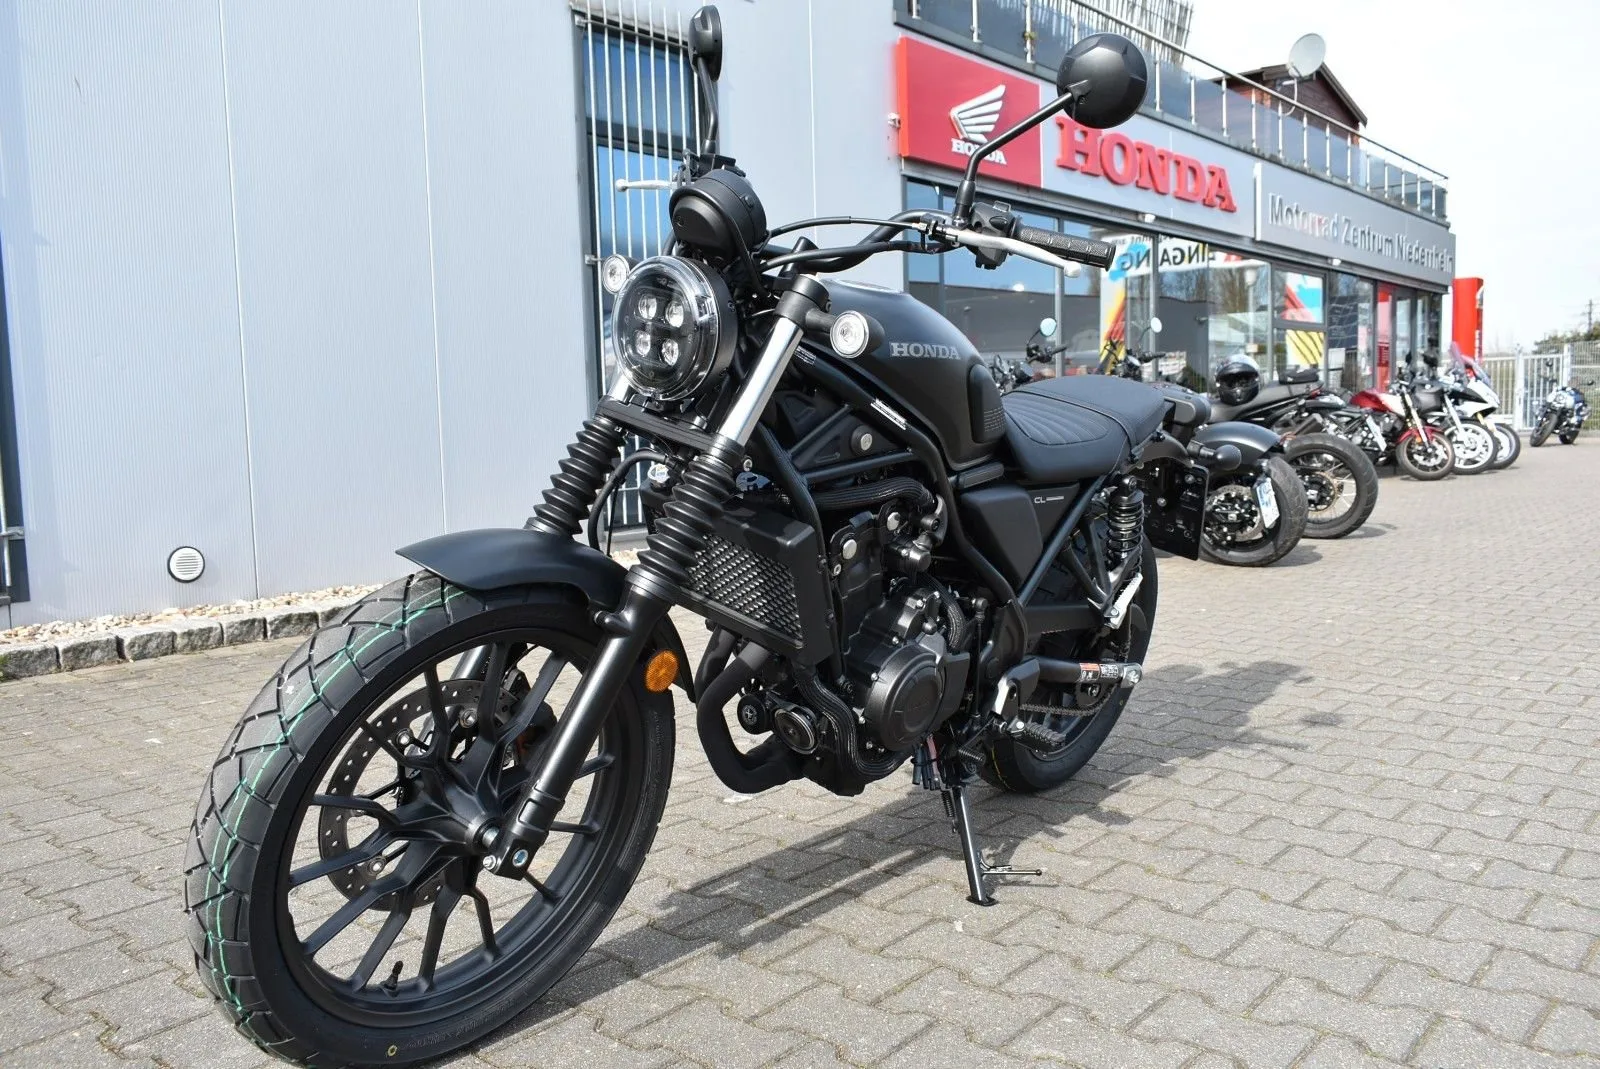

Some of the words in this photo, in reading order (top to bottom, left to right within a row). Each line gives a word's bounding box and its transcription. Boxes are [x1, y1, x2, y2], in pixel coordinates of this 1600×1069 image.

[1056, 115, 1236, 213] HONDA
[1269, 193, 1338, 238] Motorrad
[1342, 215, 1393, 257] Zentrum
[1395, 233, 1453, 273] Niederrhein
[890, 342, 961, 360] HONDA
